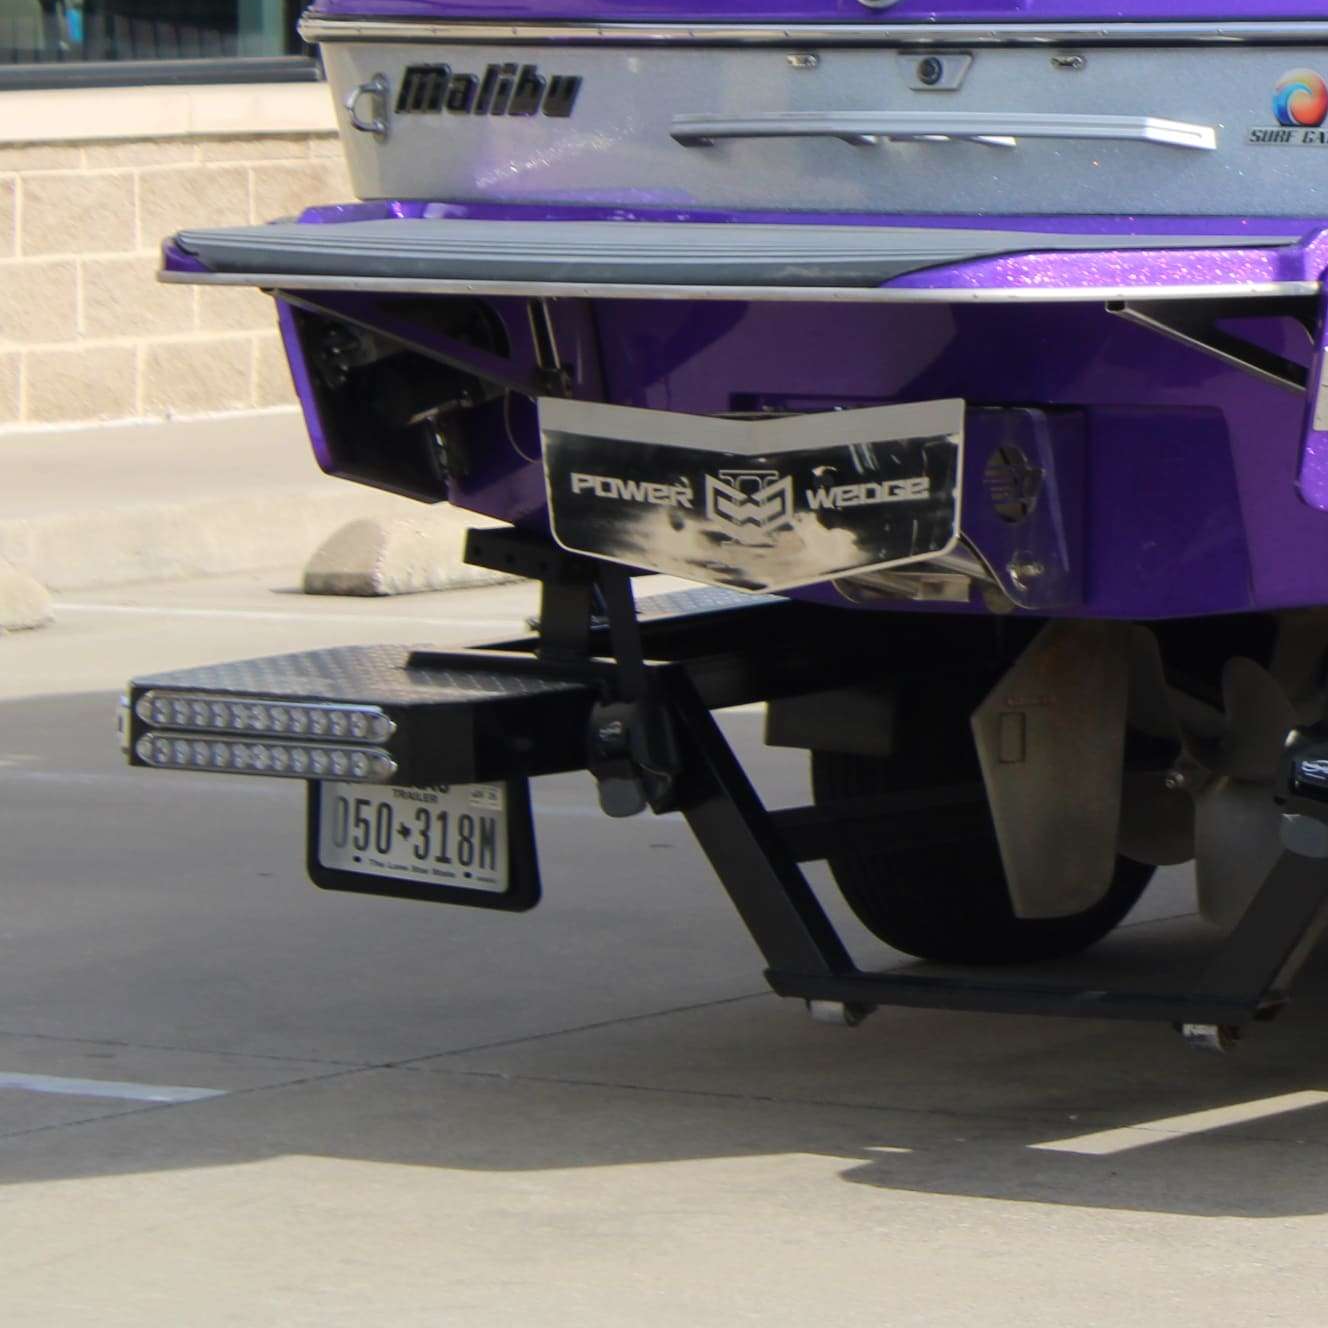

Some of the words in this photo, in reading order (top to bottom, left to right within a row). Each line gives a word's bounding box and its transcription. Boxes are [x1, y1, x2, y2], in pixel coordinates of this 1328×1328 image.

[394, 63, 583, 118] Malibu
[1249, 128, 1296, 143] SURF
[571, 472, 694, 508] POWER
[806, 476, 930, 510] WEDGE
